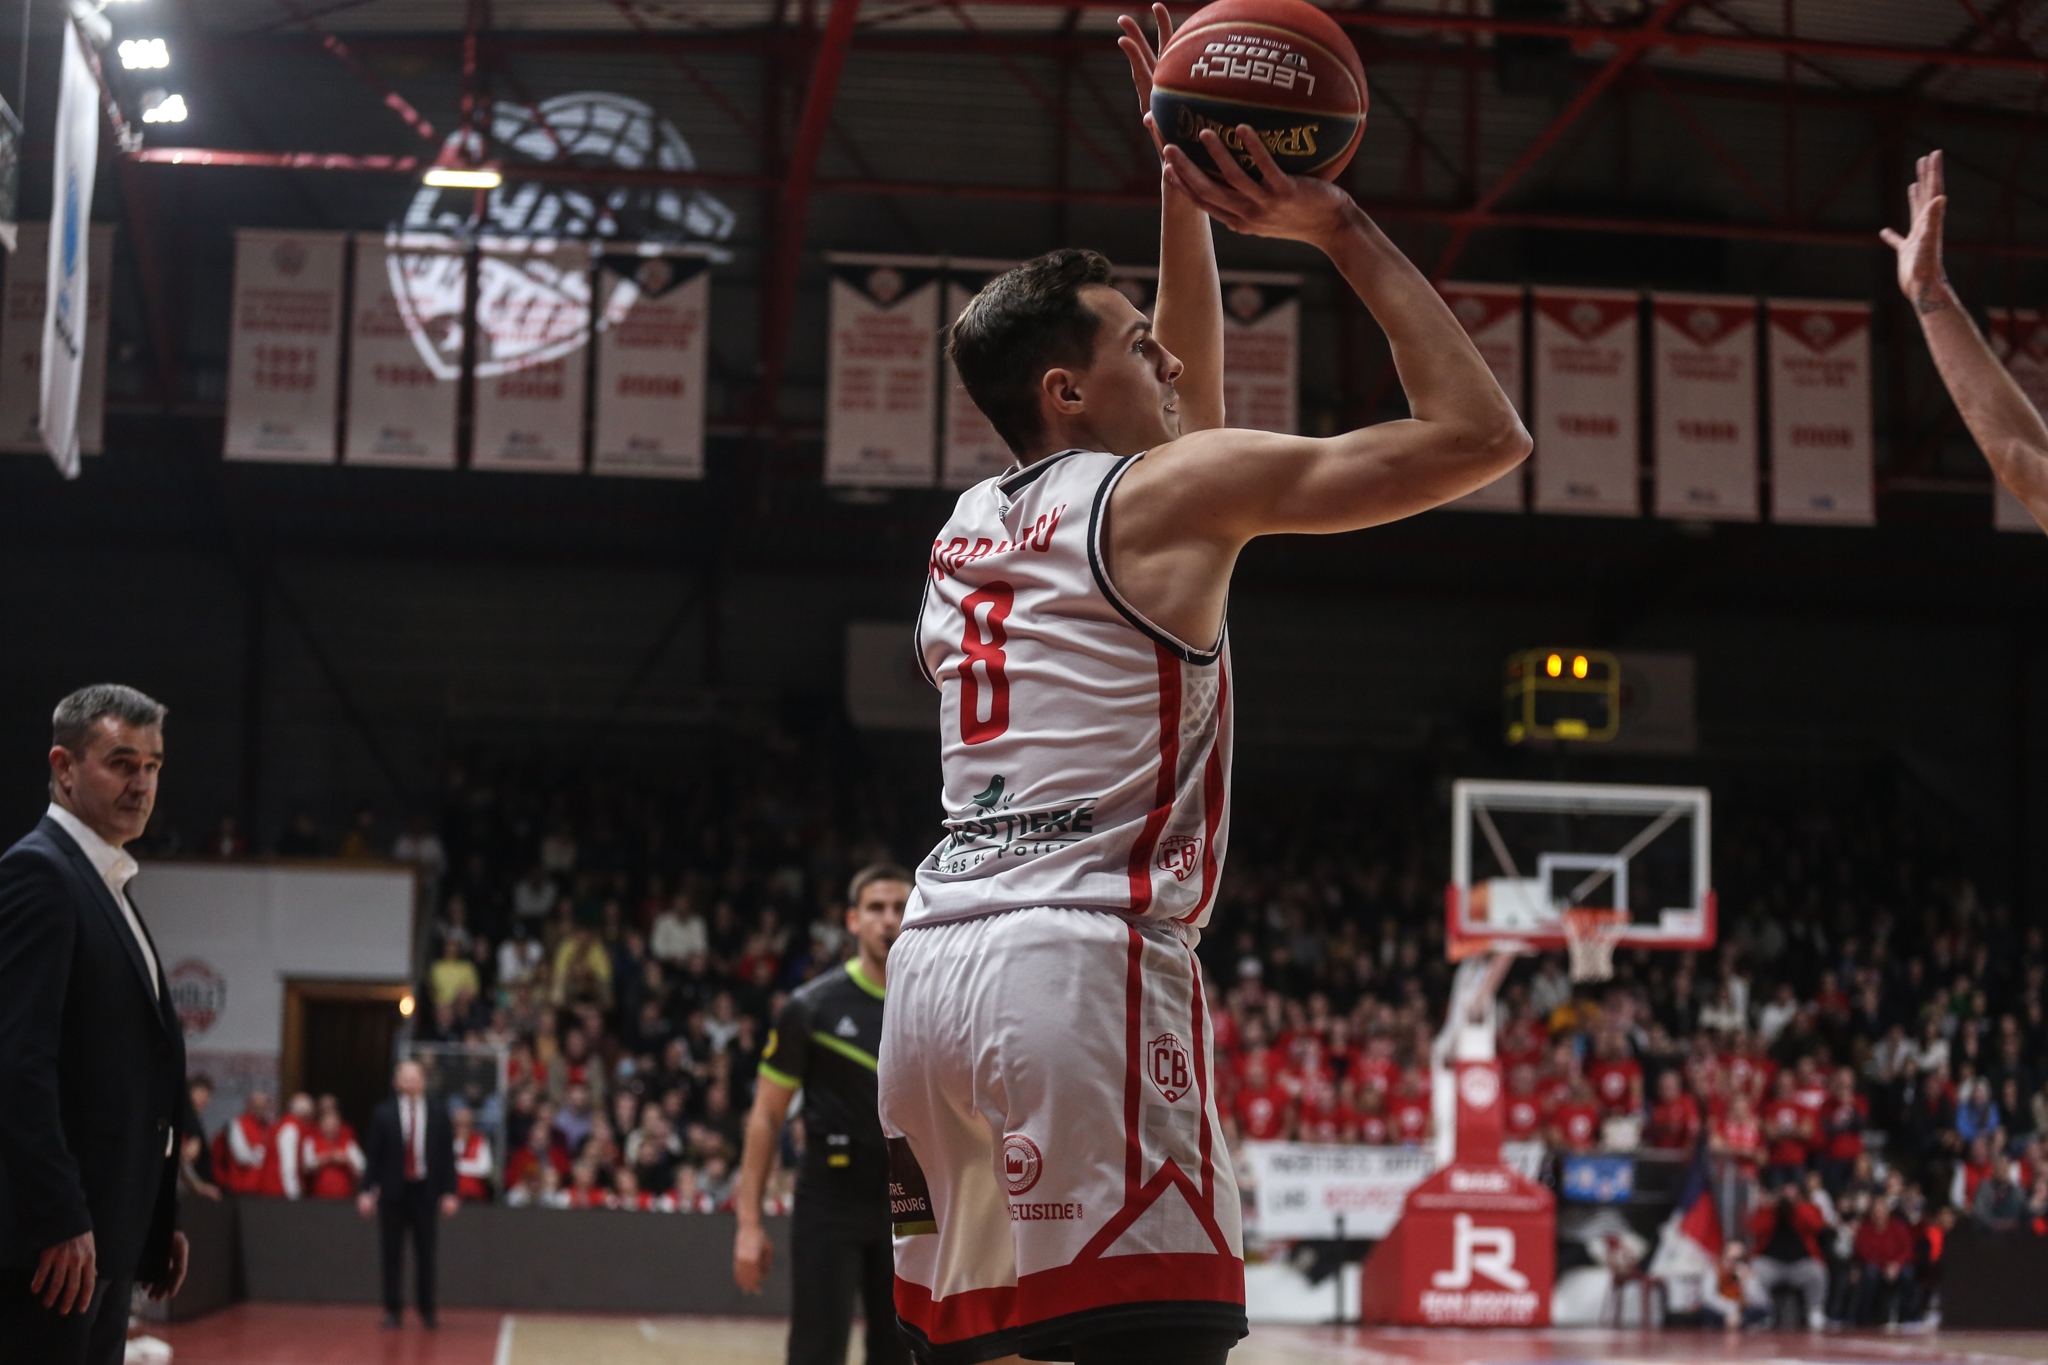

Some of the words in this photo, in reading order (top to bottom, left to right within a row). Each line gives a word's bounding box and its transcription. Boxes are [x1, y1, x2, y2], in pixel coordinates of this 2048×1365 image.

[1189, 55, 1317, 97] LEGACY
[958, 581, 1014, 745] 8
[1163, 843, 1196, 872] CB
[1155, 1048, 1188, 1088] CB
[891, 1196, 927, 1214] BOURG
[1008, 1203, 1074, 1221] EUSINE
